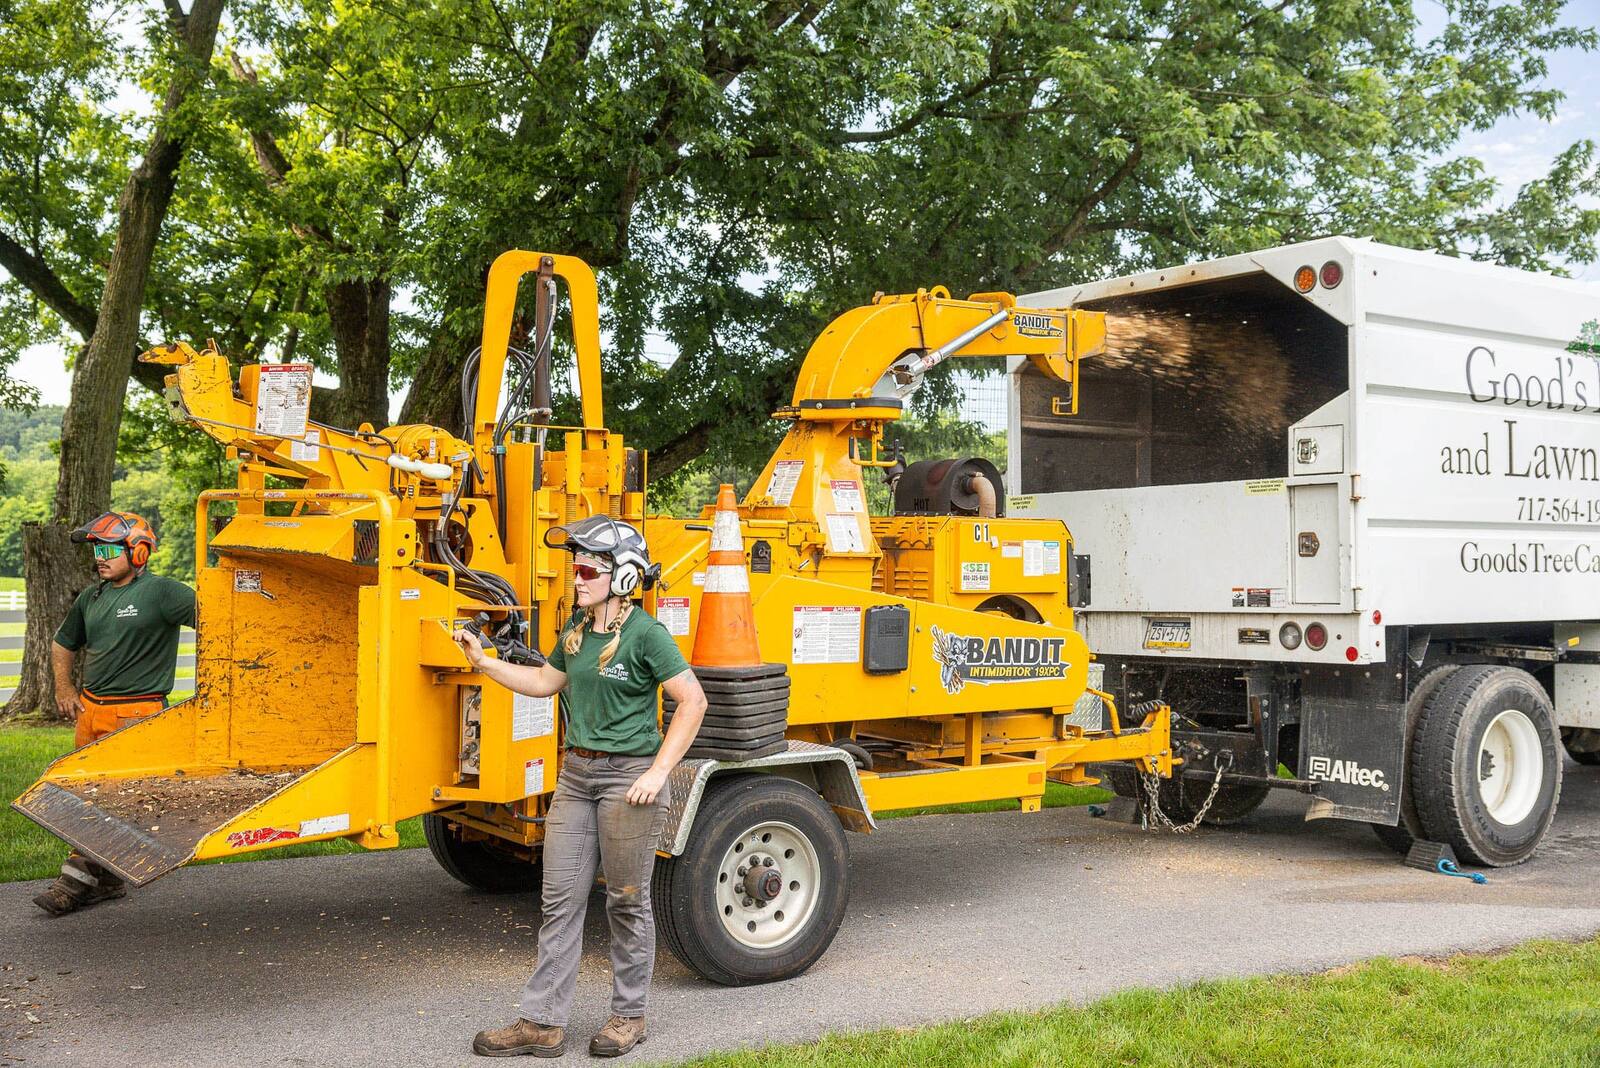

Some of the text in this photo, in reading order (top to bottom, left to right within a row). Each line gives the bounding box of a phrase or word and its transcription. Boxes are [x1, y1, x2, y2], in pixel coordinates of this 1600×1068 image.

[1014, 314, 1051, 329] BANDIT
[1466, 346, 1587, 412] Good's
[1441, 420, 1600, 481] and Lawn
[1460, 541, 1600, 573] GoodsTreeCa
[966, 638, 1064, 664] BANDIT
[970, 666, 1060, 677] INTIMIDATOR 19XPC
[1330, 760, 1385, 788] Altec
